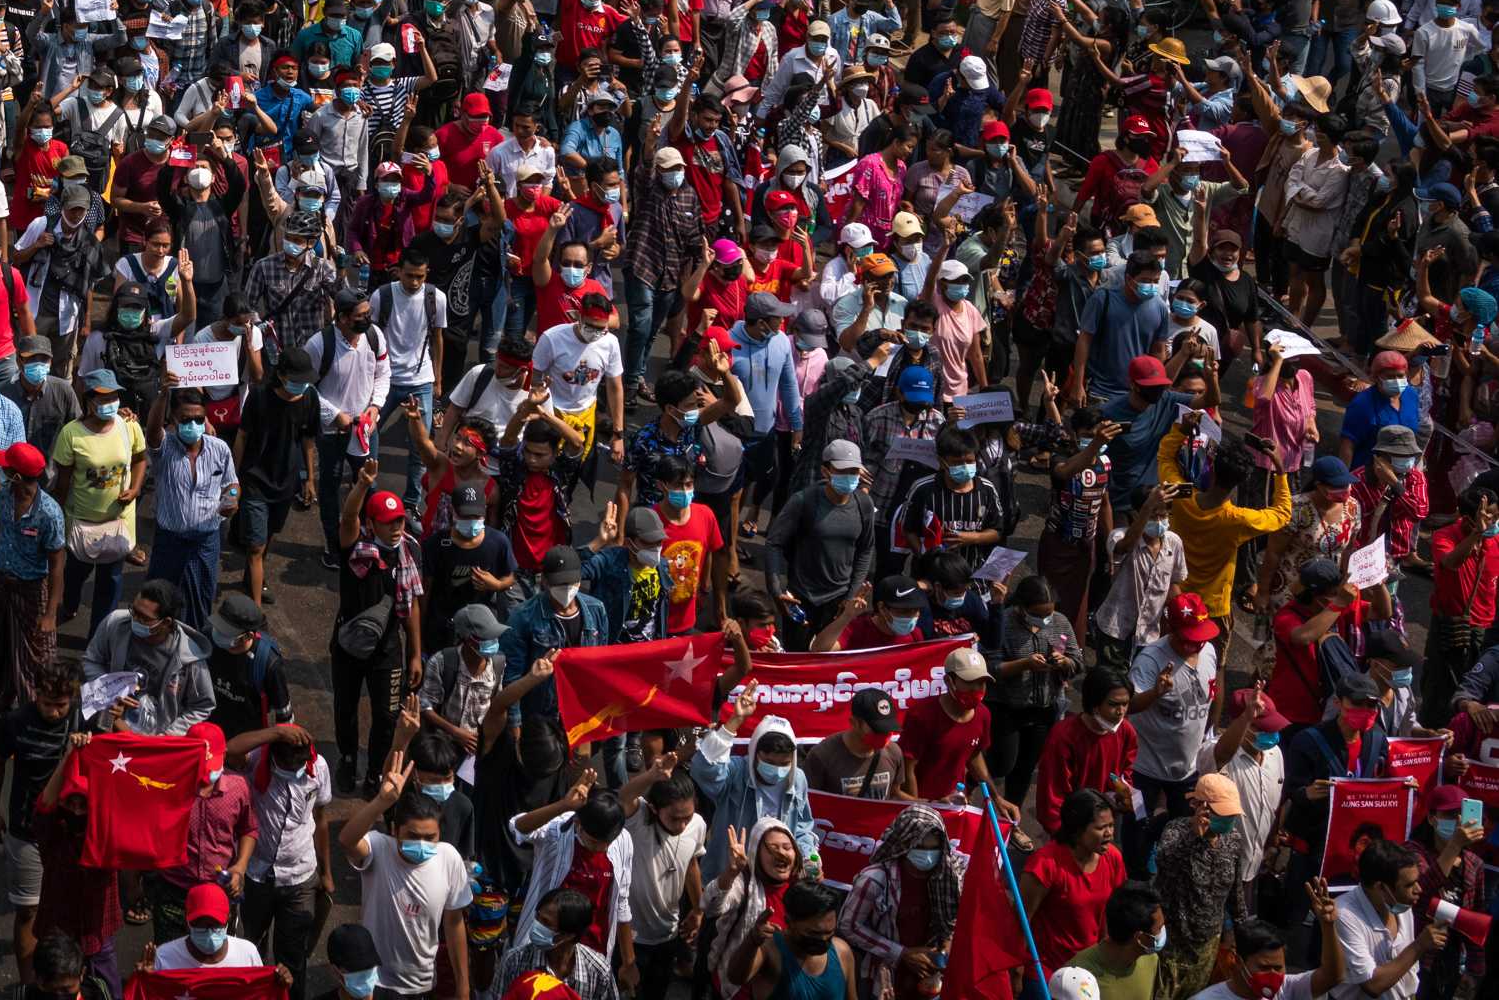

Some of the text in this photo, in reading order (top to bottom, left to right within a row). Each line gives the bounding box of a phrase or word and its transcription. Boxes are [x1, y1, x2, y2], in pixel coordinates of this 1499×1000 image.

[1341, 800, 1360, 808] AUNG
[1360, 800, 1374, 808] SAN
[1374, 800, 1388, 808] SUU
